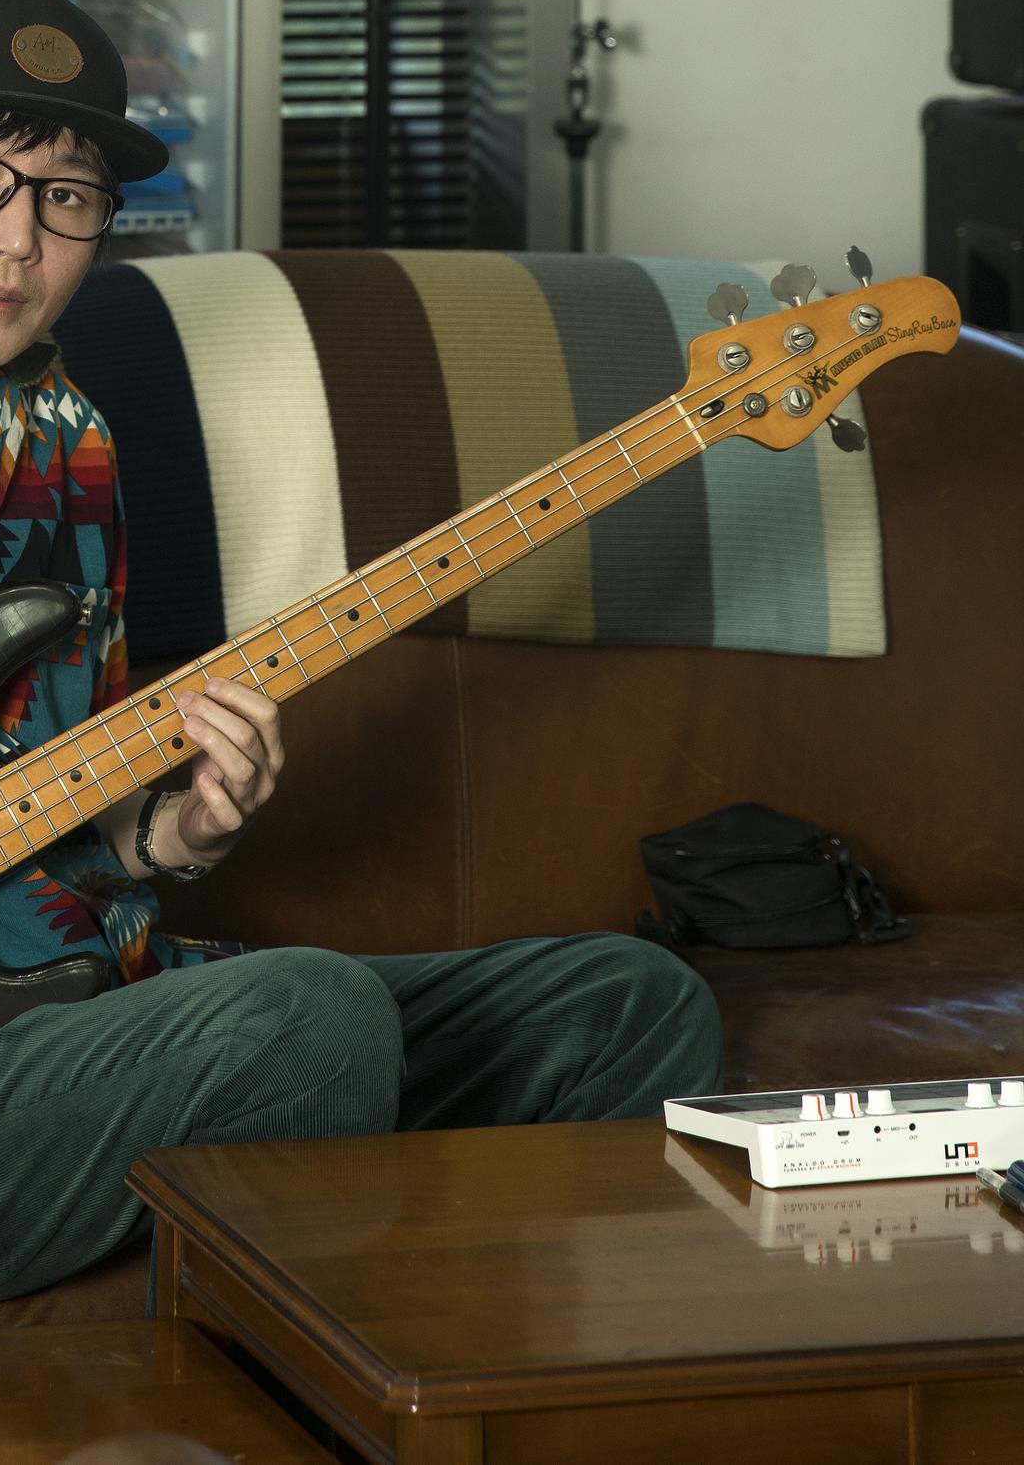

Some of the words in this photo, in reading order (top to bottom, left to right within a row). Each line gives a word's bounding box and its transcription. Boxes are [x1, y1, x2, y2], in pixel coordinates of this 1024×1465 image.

[830, 350, 863, 377] MUSIC
[944, 1142, 979, 1160] UNO
[783, 1160, 825, 1169] ANALOG
[833, 1157, 861, 1166] DRUM
[945, 1160, 980, 1168] DRUM
